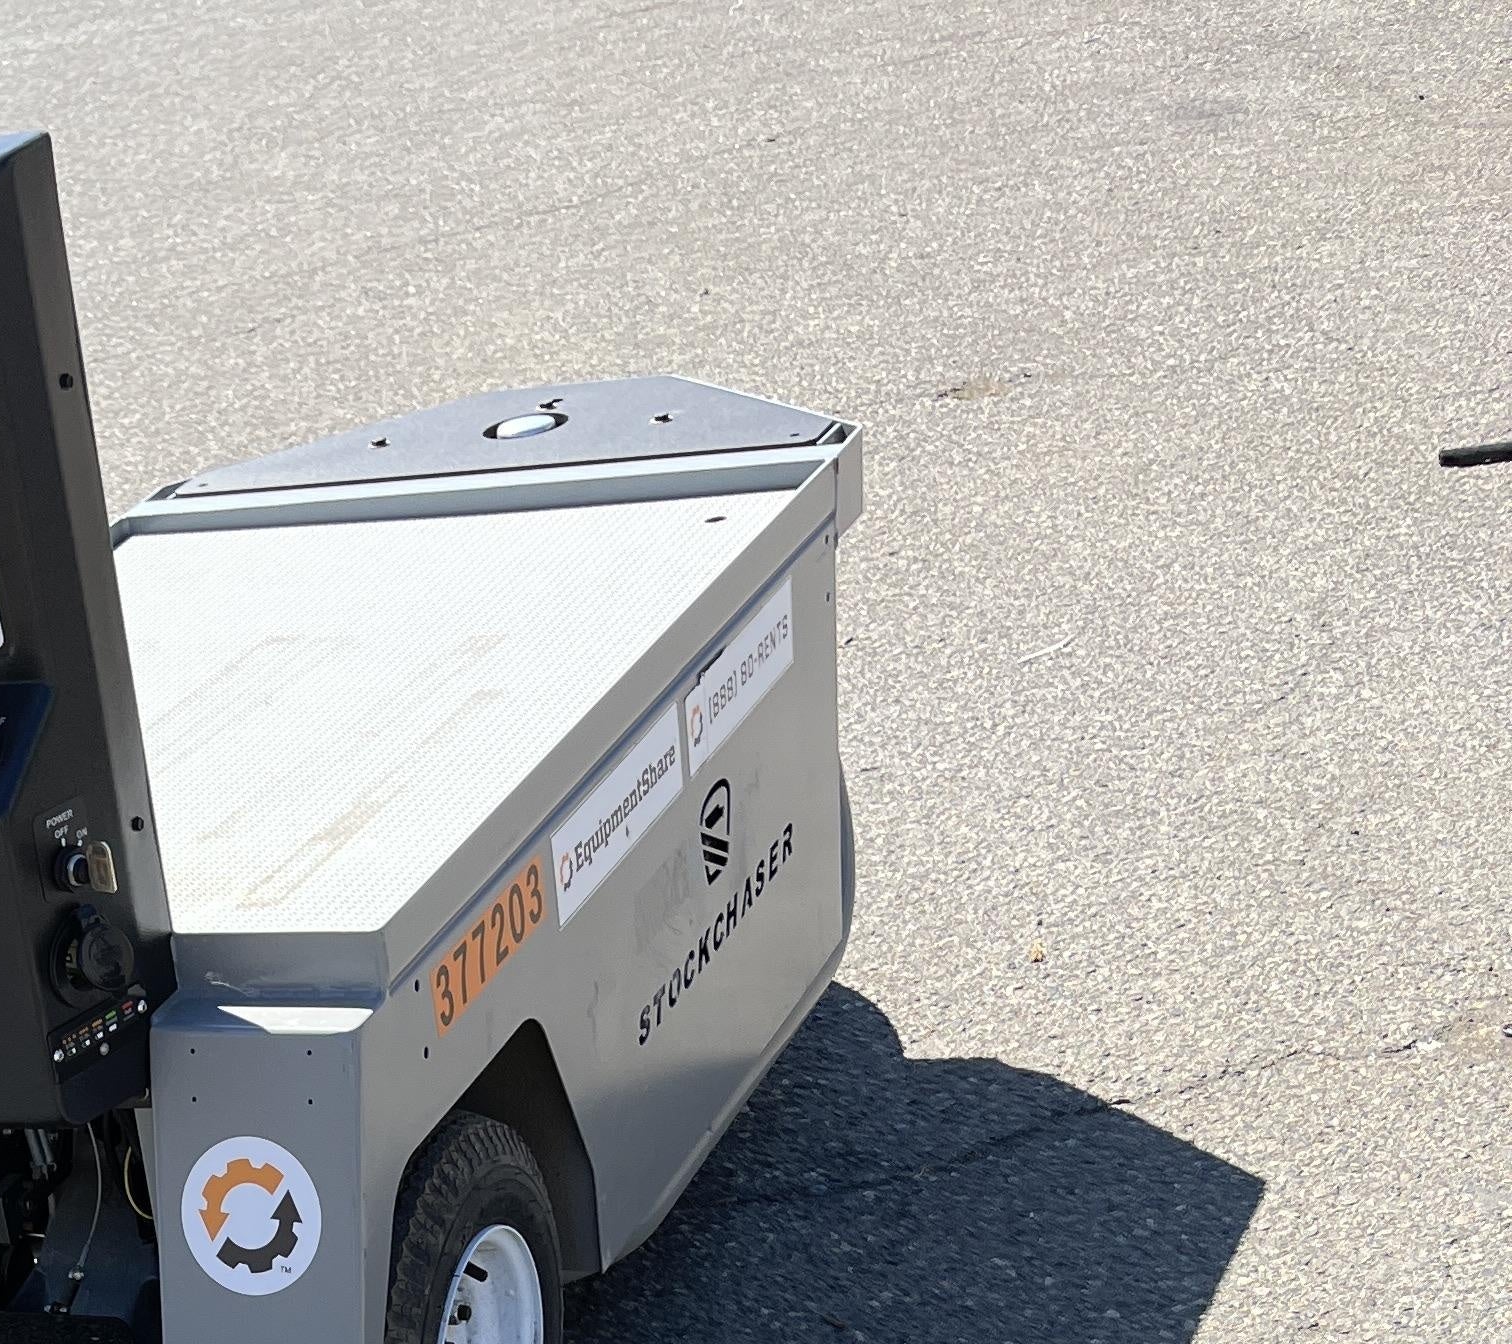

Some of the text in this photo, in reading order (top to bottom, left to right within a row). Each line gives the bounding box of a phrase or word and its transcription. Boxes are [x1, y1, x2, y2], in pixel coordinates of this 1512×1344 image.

[708, 614, 788, 725] (888) 80-RENTS
[0, 716, 7, 726] F
[45, 809, 74, 829] POWER
[54, 825, 70, 839] OFF
[76, 827, 88, 840] ON
[574, 744, 676, 873] EquipmentShare
[435, 863, 544, 1028] 377203
[638, 822, 794, 1046] STOCKCHASER
